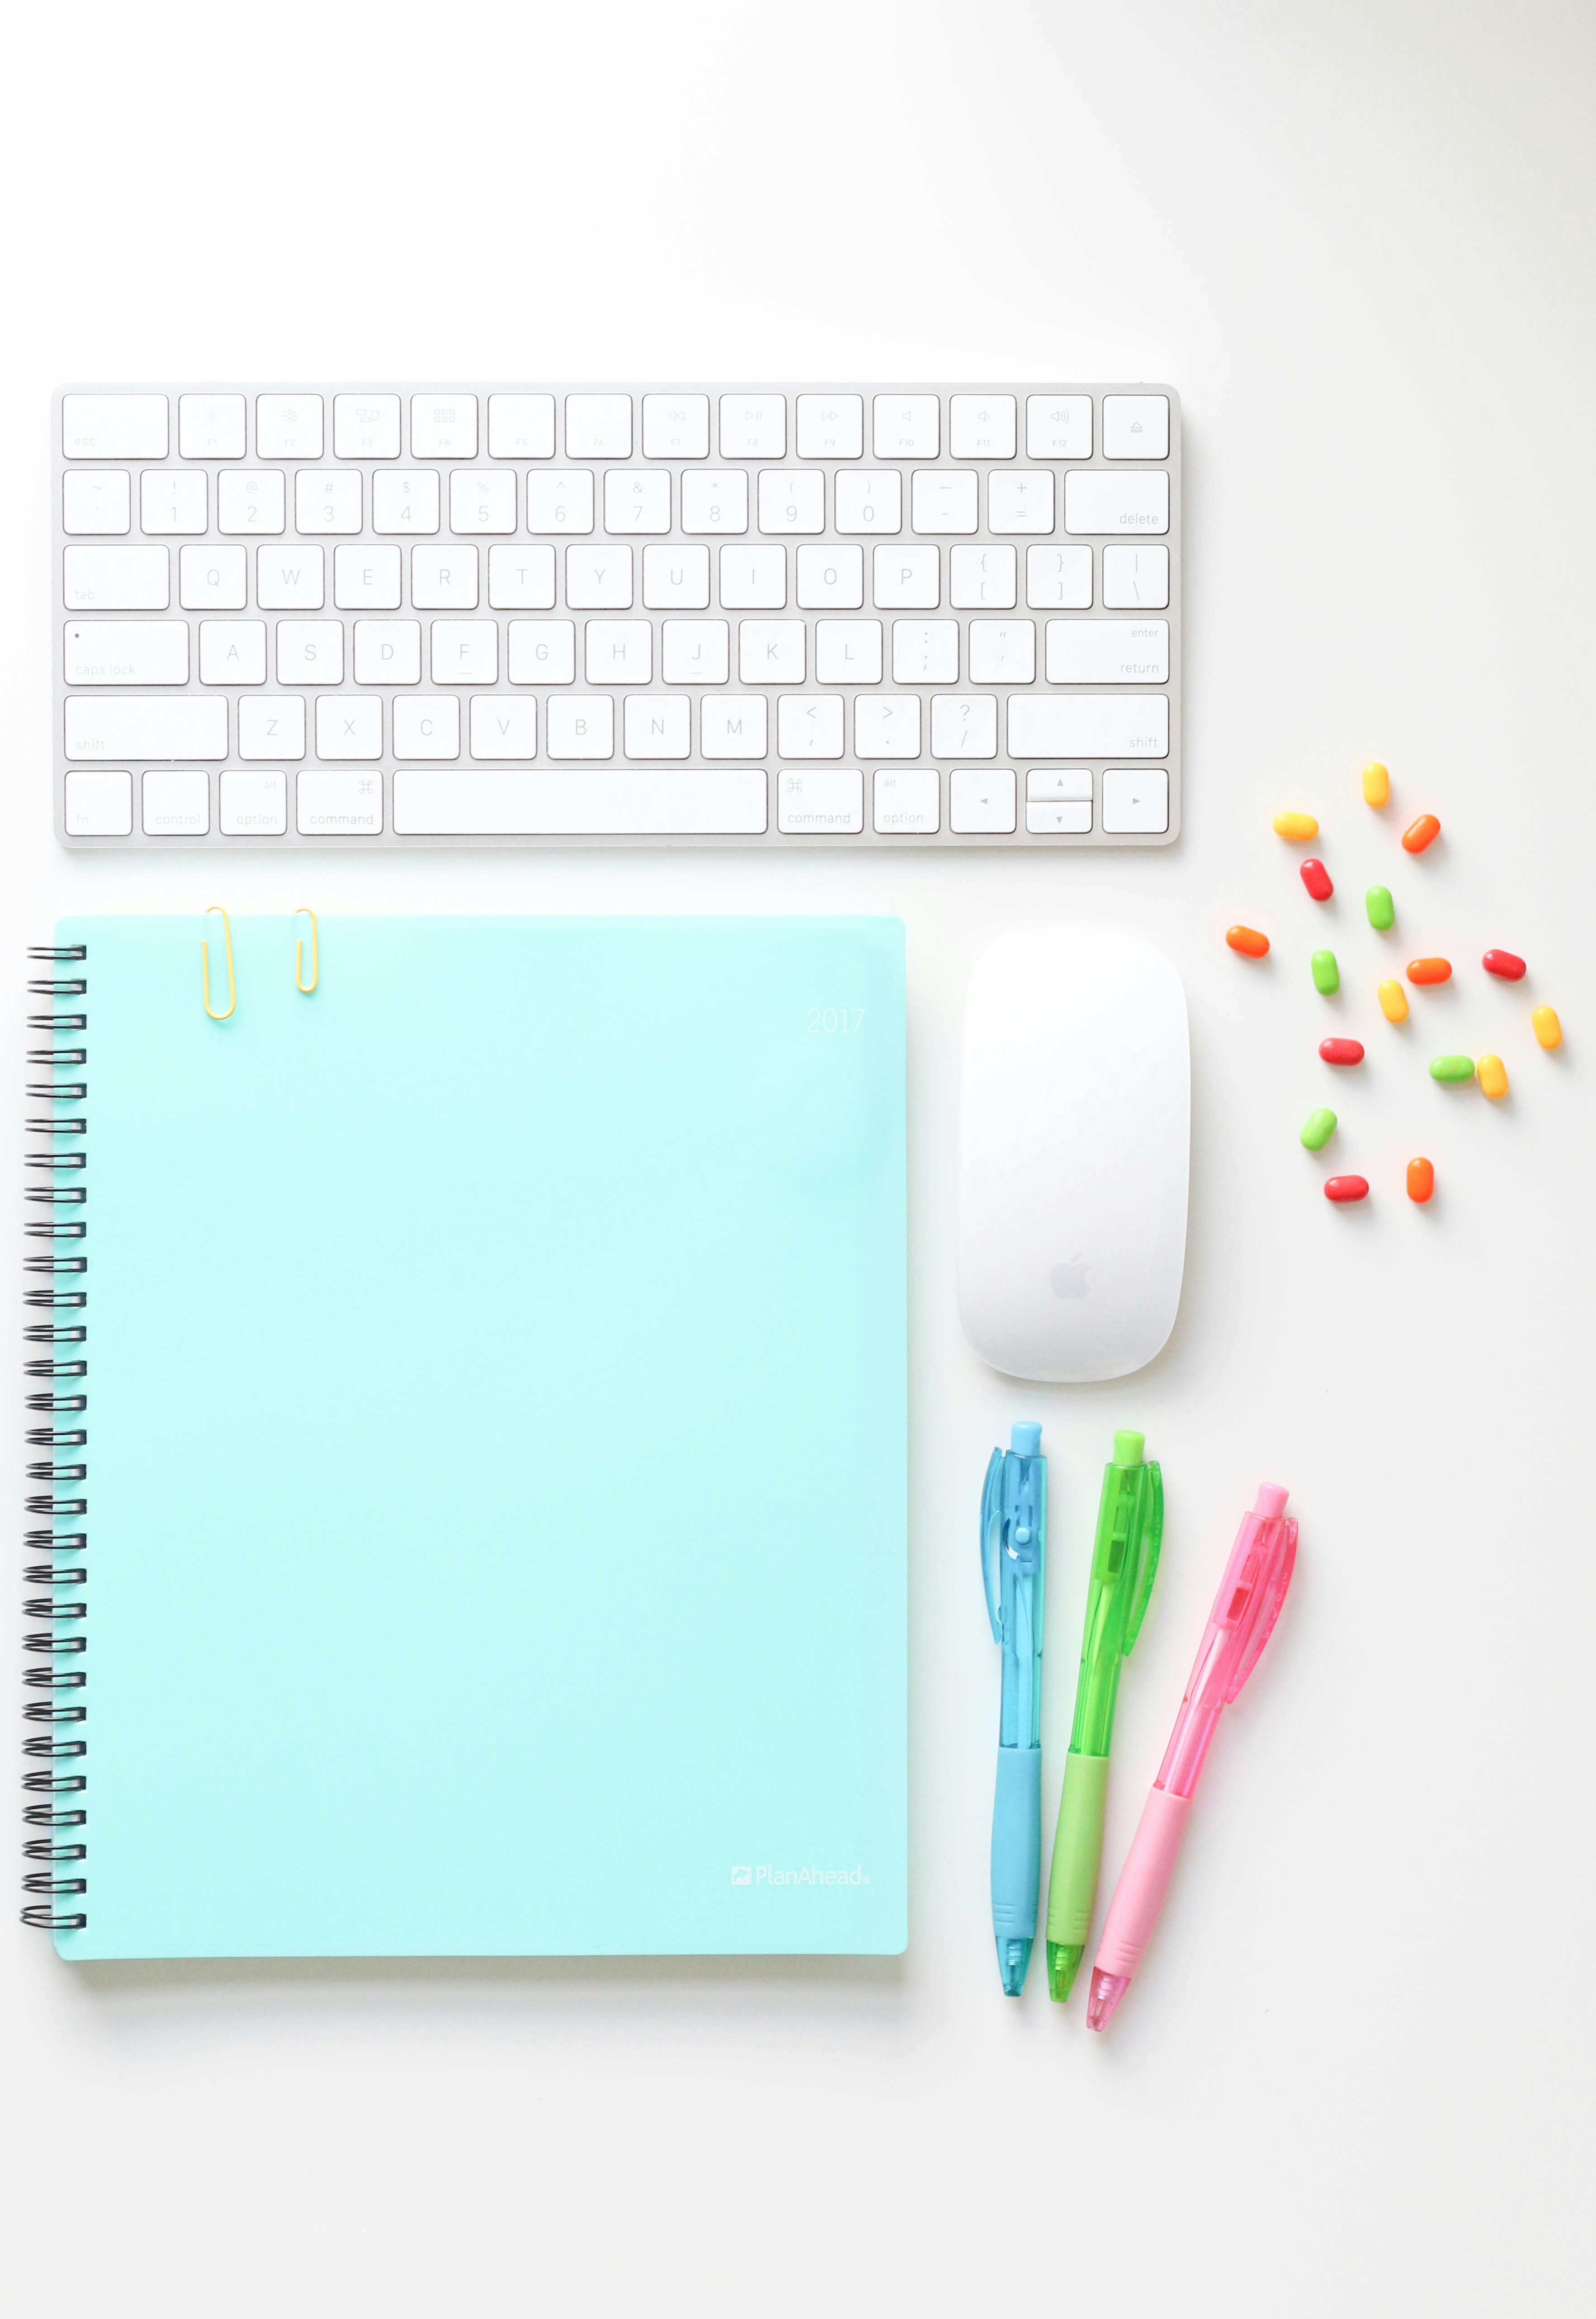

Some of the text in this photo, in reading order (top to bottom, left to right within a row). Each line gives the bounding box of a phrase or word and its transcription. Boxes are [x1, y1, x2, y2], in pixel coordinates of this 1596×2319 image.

[74, 438, 96, 447] esc
[284, 439, 295, 447] F2
[362, 439, 373, 447] F3
[516, 438, 527, 446] F5
[594, 439, 604, 447] F6
[747, 438, 759, 447] F8
[824, 439, 836, 447] F9
[899, 439, 914, 447] F10
[1052, 439, 1067, 447] F12
[246, 481, 258, 494] @
[325, 482, 333, 493] #
[402, 481, 410, 494] $
[477, 481, 489, 493] %
[633, 482, 642, 494] &
[1016, 482, 1027, 494] +
[170, 506, 176, 522] 1
[247, 506, 257, 522] 2
[324, 505, 335, 522] 3
[400, 506, 412, 521] 4
[478, 506, 489, 522] 5
[555, 506, 566, 522] 6
[633, 506, 643, 521] 7
[709, 505, 721, 522] 8
[786, 505, 798, 522] 9
[863, 505, 874, 522] 0
[1119, 513, 1158, 525] delete
[981, 554, 987, 573] {
[1057, 554, 1064, 573] }
[207, 568, 220, 587] Q
[282, 569, 300, 585] W
[363, 568, 373, 585] E
[439, 568, 451, 585] R
[516, 568, 528, 585] T
[594, 569, 605, 585] Y
[671, 569, 683, 586] U
[824, 568, 837, 585] O
[901, 568, 912, 585] P
[75, 589, 95, 600] tab
[981, 582, 986, 600] [
[1058, 582, 1063, 601] ]
[1133, 581, 1140, 601] \
[1132, 629, 1158, 638] enter
[227, 644, 239, 660] A
[304, 644, 316, 661] S
[381, 644, 394, 660] D
[460, 644, 469, 660] F
[535, 644, 548, 661] G
[613, 644, 626, 660] H
[691, 644, 701, 660] J
[767, 644, 778, 659] K
[845, 644, 855, 660] L
[76, 664, 135, 677] caps lock
[1120, 663, 1159, 673] return
[806, 706, 817, 719] <
[883, 706, 893, 719] >
[960, 704, 970, 721] ?
[266, 719, 278, 736] Z
[344, 719, 355, 735] X
[420, 719, 433, 736] C
[497, 719, 510, 735] V
[575, 719, 587, 735] B
[652, 719, 664, 735] N
[727, 719, 742, 734] M
[76, 739, 105, 750] shift
[960, 729, 968, 748] /
[1129, 737, 1157, 748] shift
[264, 781, 277, 789] alt
[883, 779, 896, 788] alt
[76, 814, 89, 825] fn
[155, 814, 200, 825] control
[236, 814, 277, 826] option
[311, 814, 373, 825] command
[788, 813, 850, 823] command
[883, 812, 924, 825] option
[807, 1008, 865, 1033] 2017
